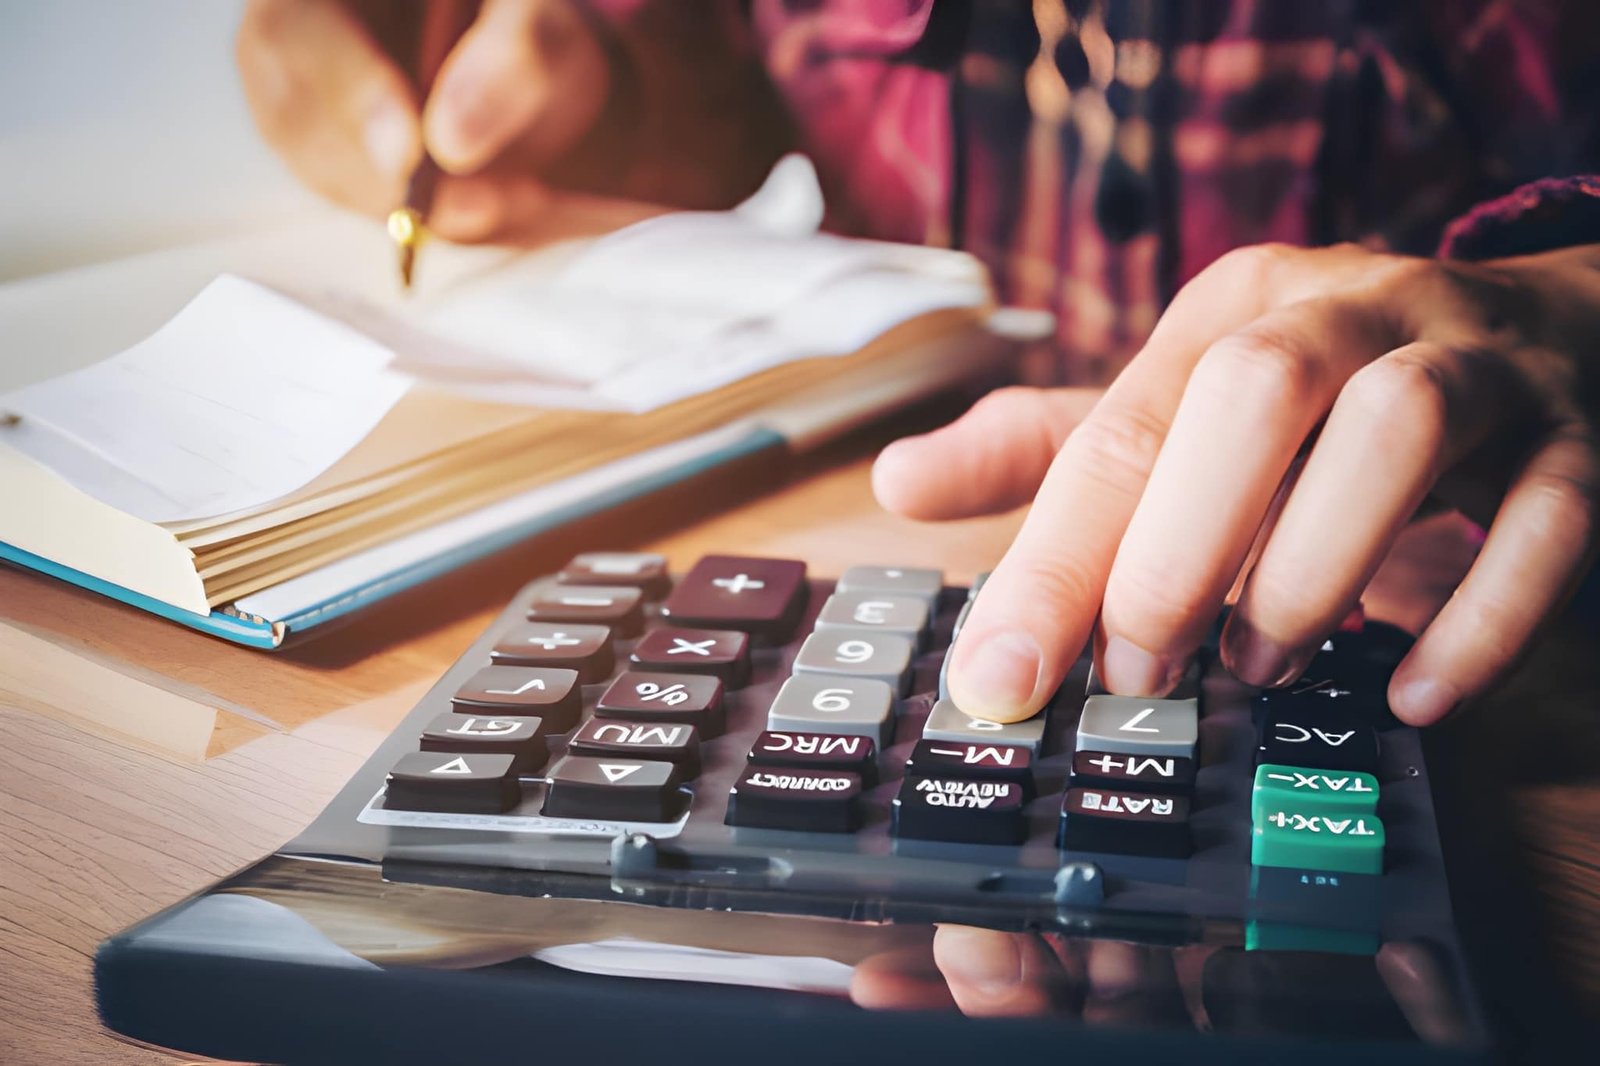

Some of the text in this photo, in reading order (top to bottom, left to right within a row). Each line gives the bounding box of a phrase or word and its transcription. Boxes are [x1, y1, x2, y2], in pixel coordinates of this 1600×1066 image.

[835, 640, 875, 664] 6
[812, 687, 855, 713] 9
[1119, 708, 1161, 733] 7
[593, 723, 682, 746] MU
[763, 732, 860, 755] MRC
[1275, 722, 1356, 747] AC
[1088, 753, 1175, 777] M+
[925, 792, 996, 809] AUTO
